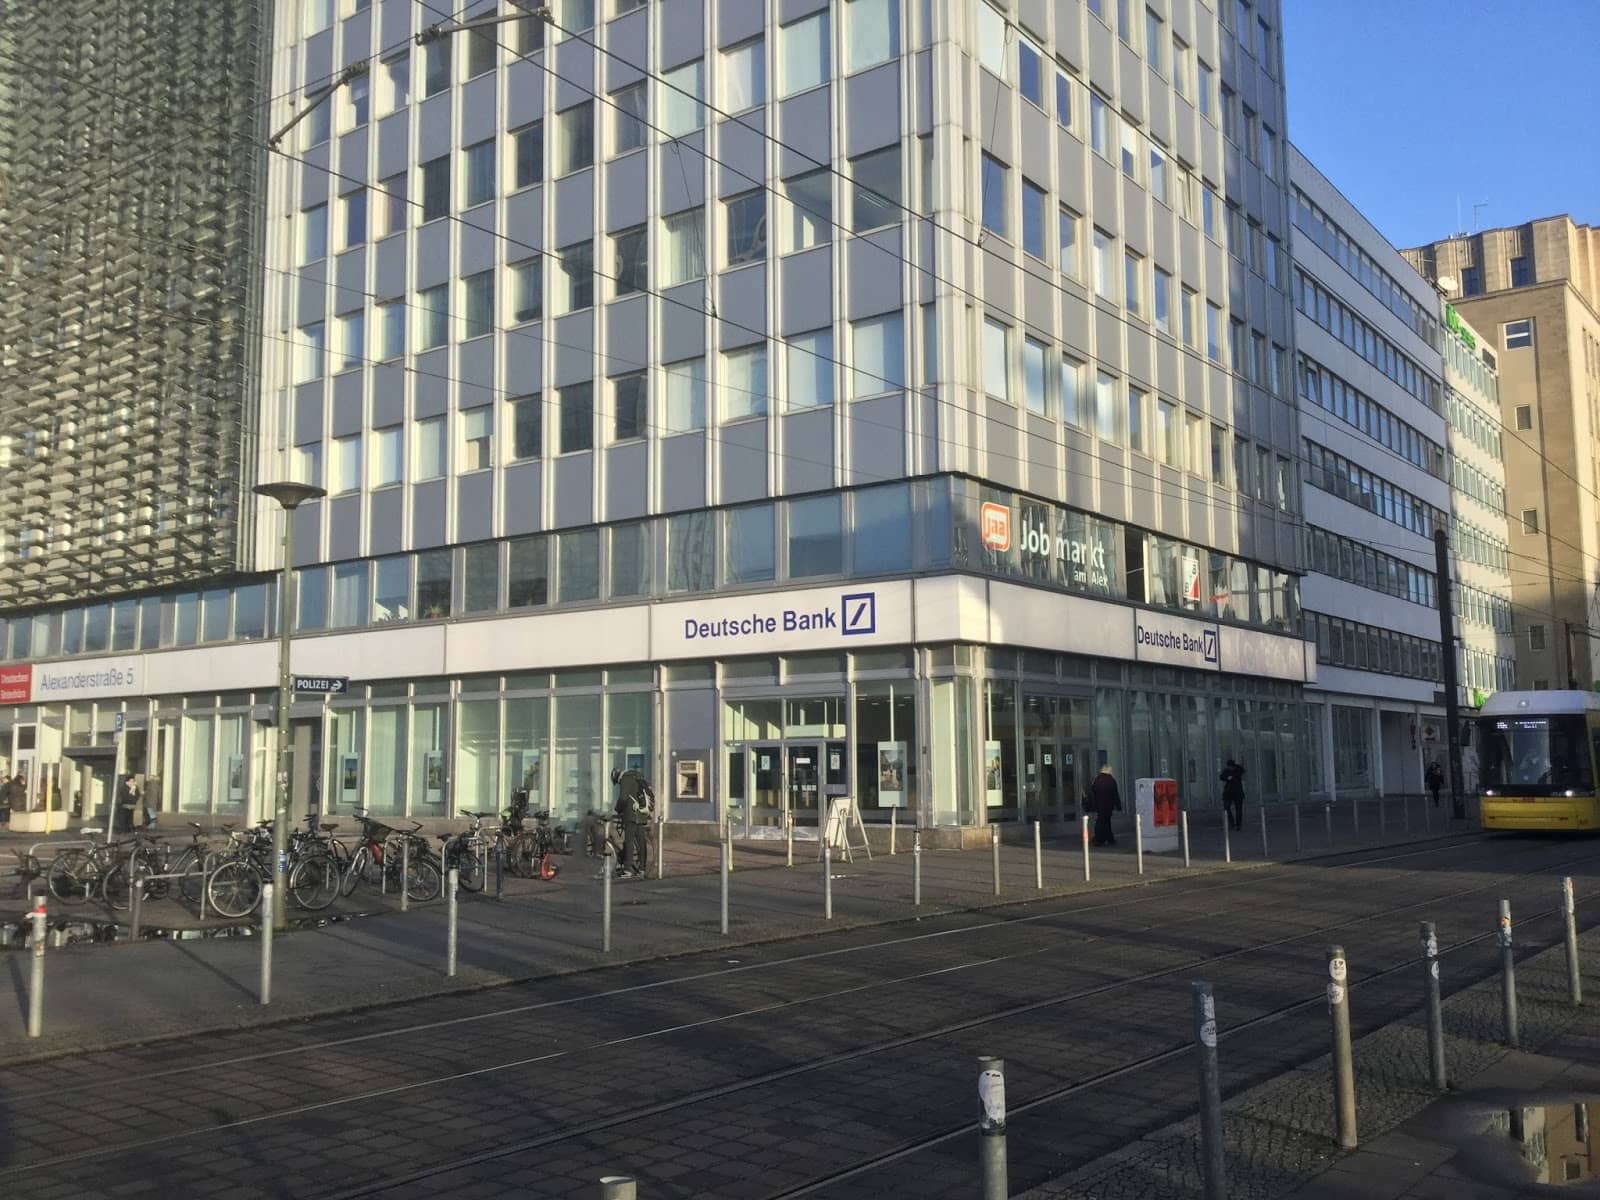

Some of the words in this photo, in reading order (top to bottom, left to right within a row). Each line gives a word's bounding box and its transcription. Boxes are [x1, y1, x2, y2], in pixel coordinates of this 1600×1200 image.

[685, 614, 776, 639] Deutsche
[783, 608, 836, 631] Bank
[1137, 625, 1180, 649] Deutsche
[1183, 633, 1204, 653] Bank
[41, 668, 123, 690] Alexanderstraße
[126, 667, 134, 685] 5
[297, 679, 329, 689] POLIZEI
